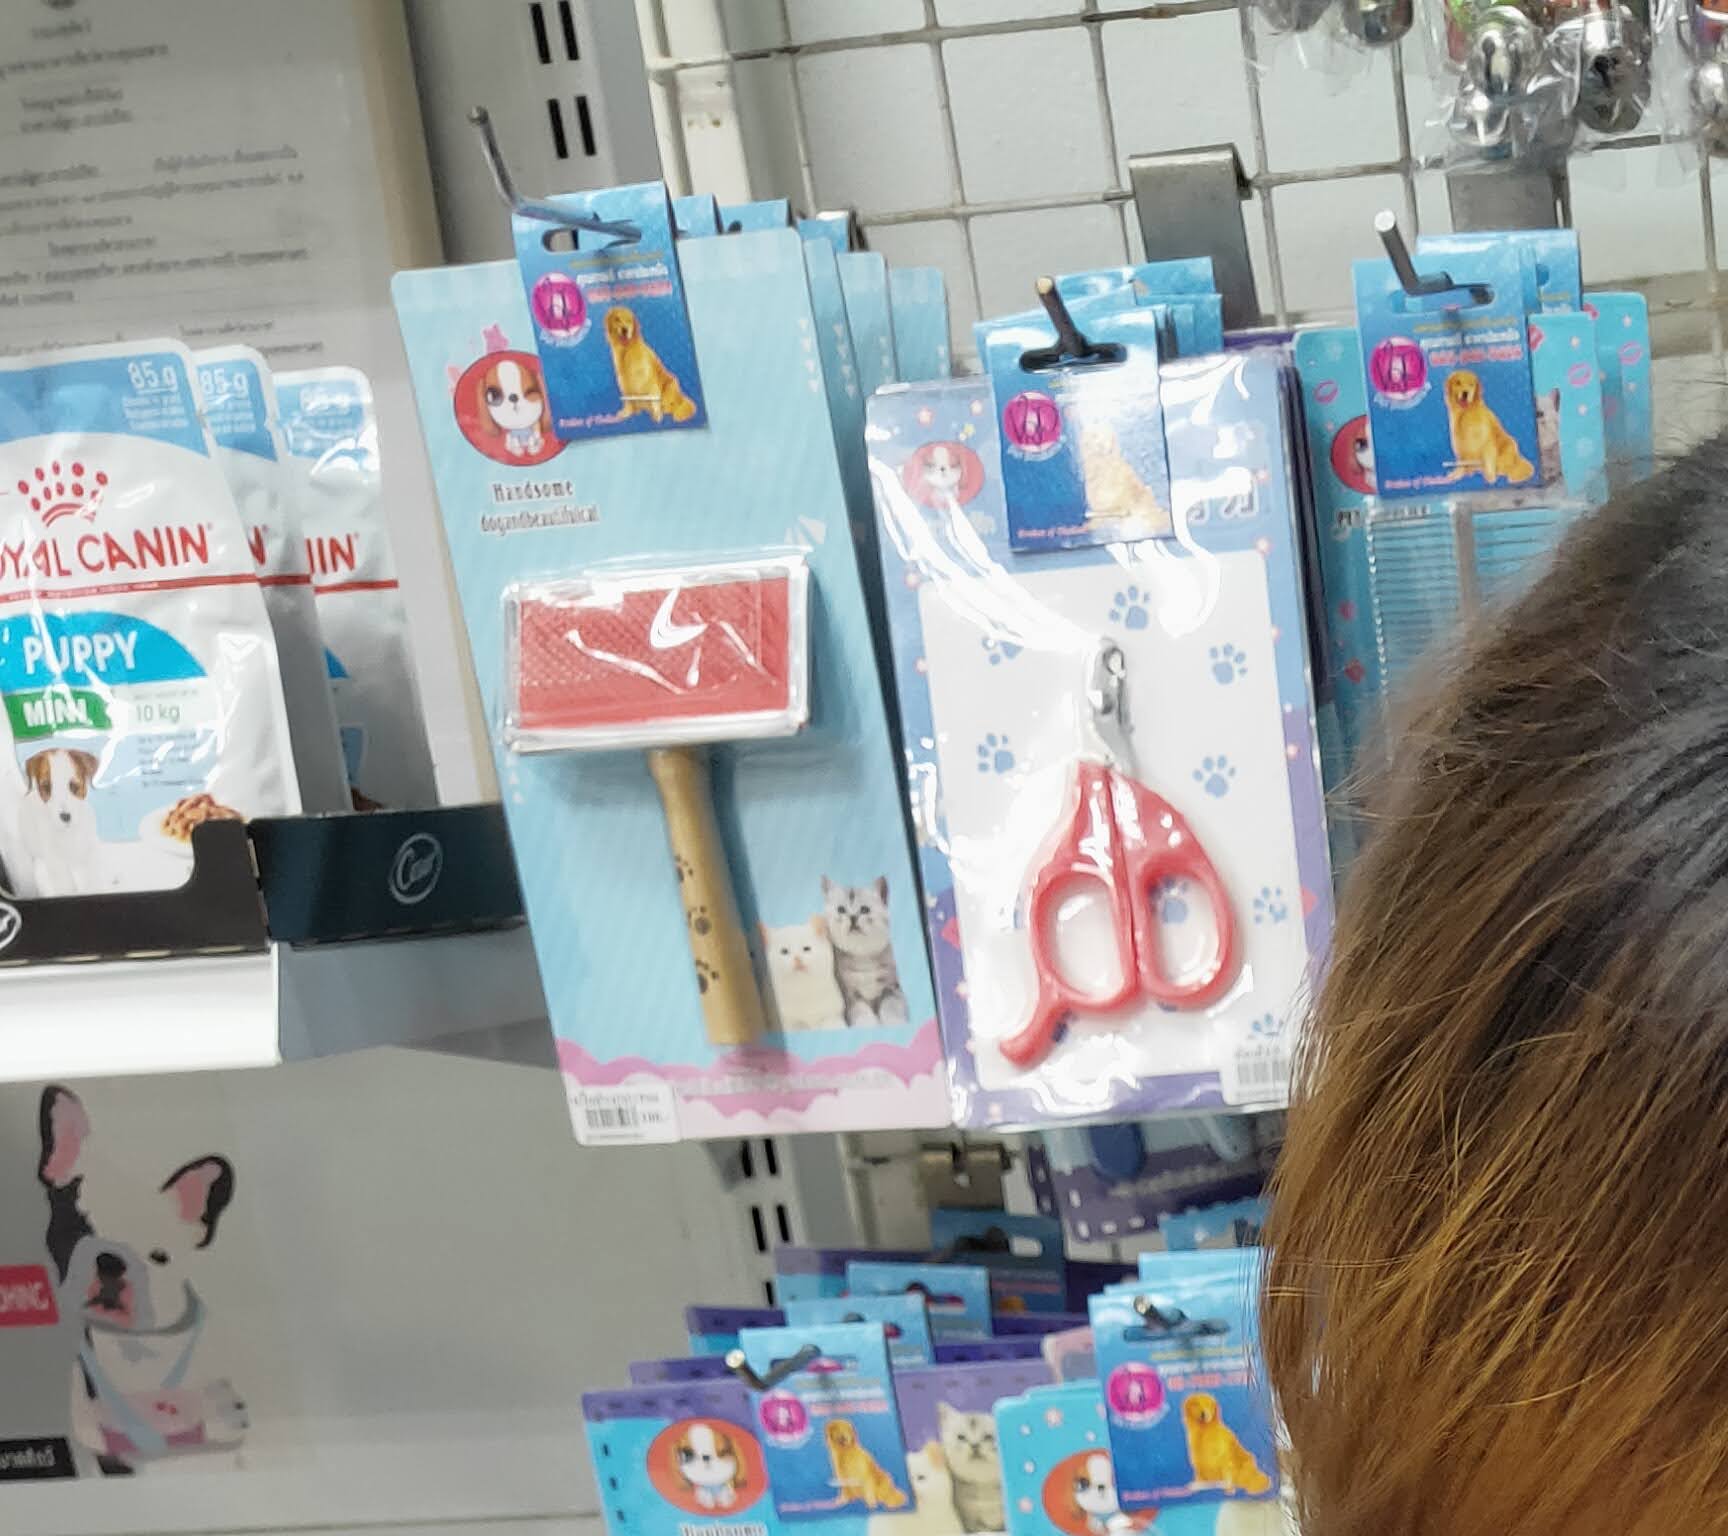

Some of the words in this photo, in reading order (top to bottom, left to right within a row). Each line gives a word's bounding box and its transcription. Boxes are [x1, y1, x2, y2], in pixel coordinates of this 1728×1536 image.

[128, 361, 160, 389] 85
[161, 366, 179, 393] g
[77, 525, 209, 573] CANIN
[22, 630, 138, 675] PUPPY
[136, 704, 154, 722] 10
[158, 703, 181, 723] kg
